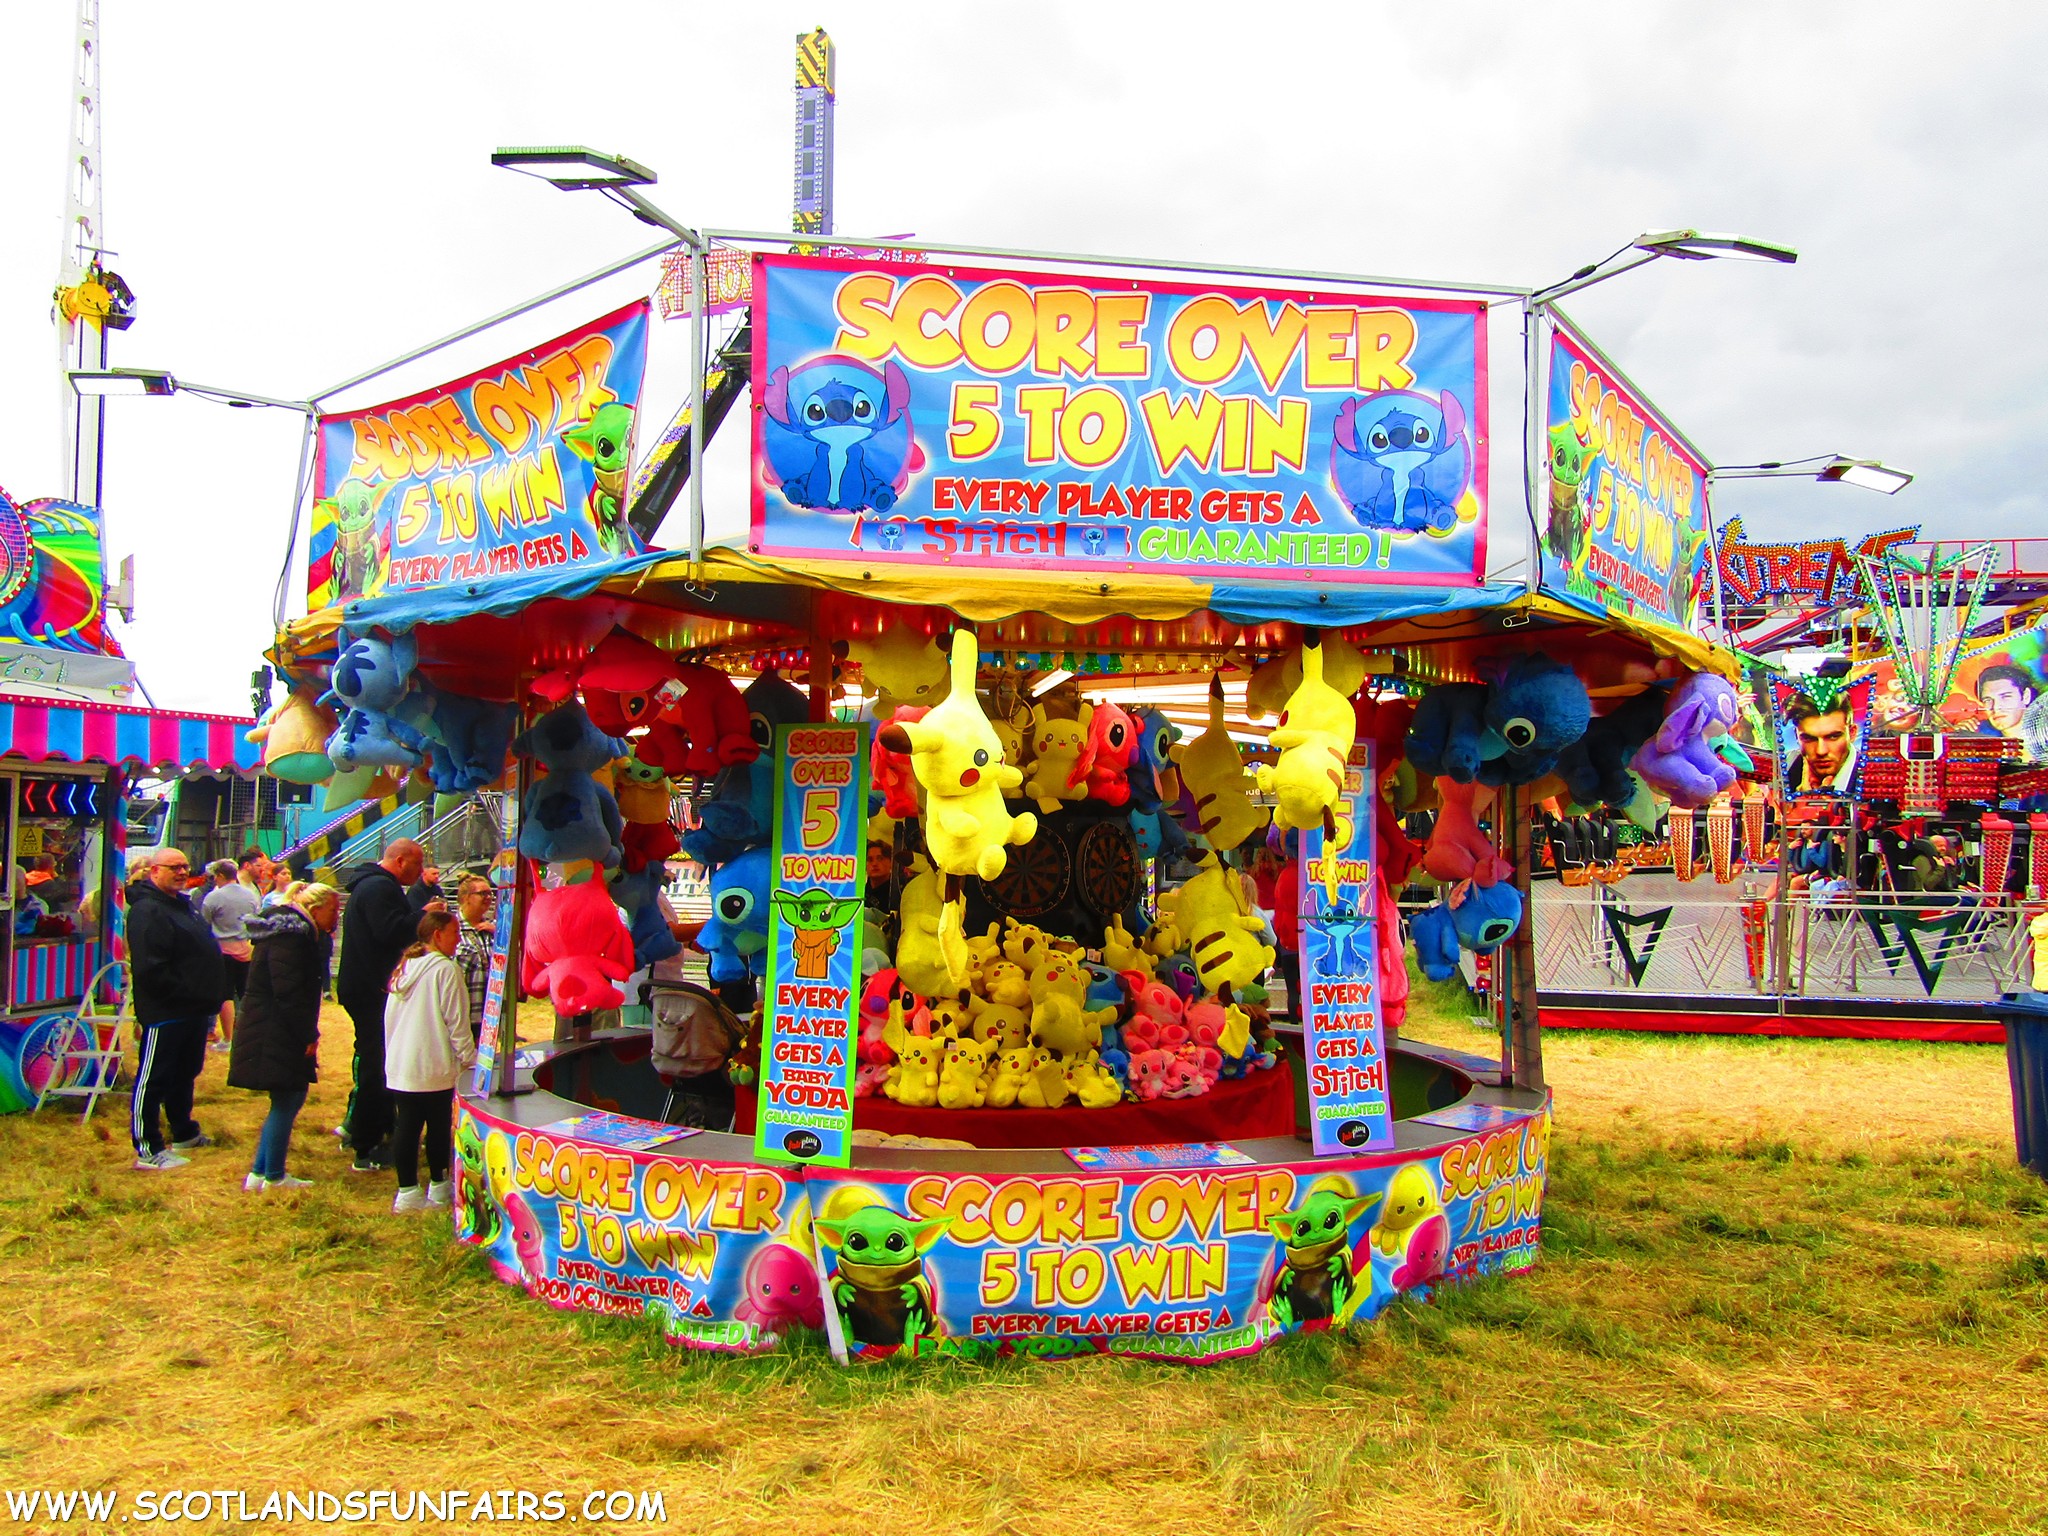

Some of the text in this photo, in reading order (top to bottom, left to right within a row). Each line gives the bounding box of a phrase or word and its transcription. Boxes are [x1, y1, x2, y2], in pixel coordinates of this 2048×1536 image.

[834, 271, 1419, 393] SCORE OVER
[349, 333, 619, 480] SCORE OVER
[946, 382, 1311, 478] 5 TO WIN
[1568, 360, 1695, 519] SCORE OVER
[397, 443, 567, 546] 5 TO WIN
[932, 477, 1324, 526] EVERY PLAYER GETS A
[1592, 468, 1674, 577] 5 TO WIN
[389, 528, 590, 586] EVERY PLAYER GETS A
[1139, 526, 1371, 566] GUARANTEED
[1588, 544, 1621, 585] EVERY
[1619, 561, 1650, 604] PLAYER
[1647, 580, 1664, 611] GETS
[787, 728, 858, 757] SCORE
[792, 760, 852, 786] OVER
[802, 788, 840, 850] 5
[782, 854, 856, 883] TO WIN
[1335, 859, 1369, 885] WIN
[777, 984, 850, 1010] EVERY
[1311, 983, 1373, 1006] EVERY
[775, 1015, 848, 1039] PLAYER
[1313, 1012, 1375, 1033] PLAYER
[774, 1042, 845, 1067] GETS A
[1316, 1037, 1376, 1059] GETS A
[765, 1081, 849, 1111] YODA
[782, 1068, 834, 1086] BABY
[764, 1110, 847, 1130] GUARANTEED
[1316, 1101, 1386, 1120] GUARANTEED
[515, 1132, 785, 1233] SCORE OVER
[1512, 1171, 1544, 1226] WI
[906, 1168, 1299, 1248] SCORE OVER
[557, 1201, 719, 1282] 5 TO WIN
[535, 1277, 571, 1302] OOD
[557, 1257, 714, 1318] EVERY PLAYER GETS A
[981, 1240, 1229, 1309] 5 TO WIN
[971, 1306, 1233, 1336] EVERY PLAYER GETS A
[1009, 1336, 1100, 1356] YODA
[1109, 1322, 1257, 1358] GUARANTEED
